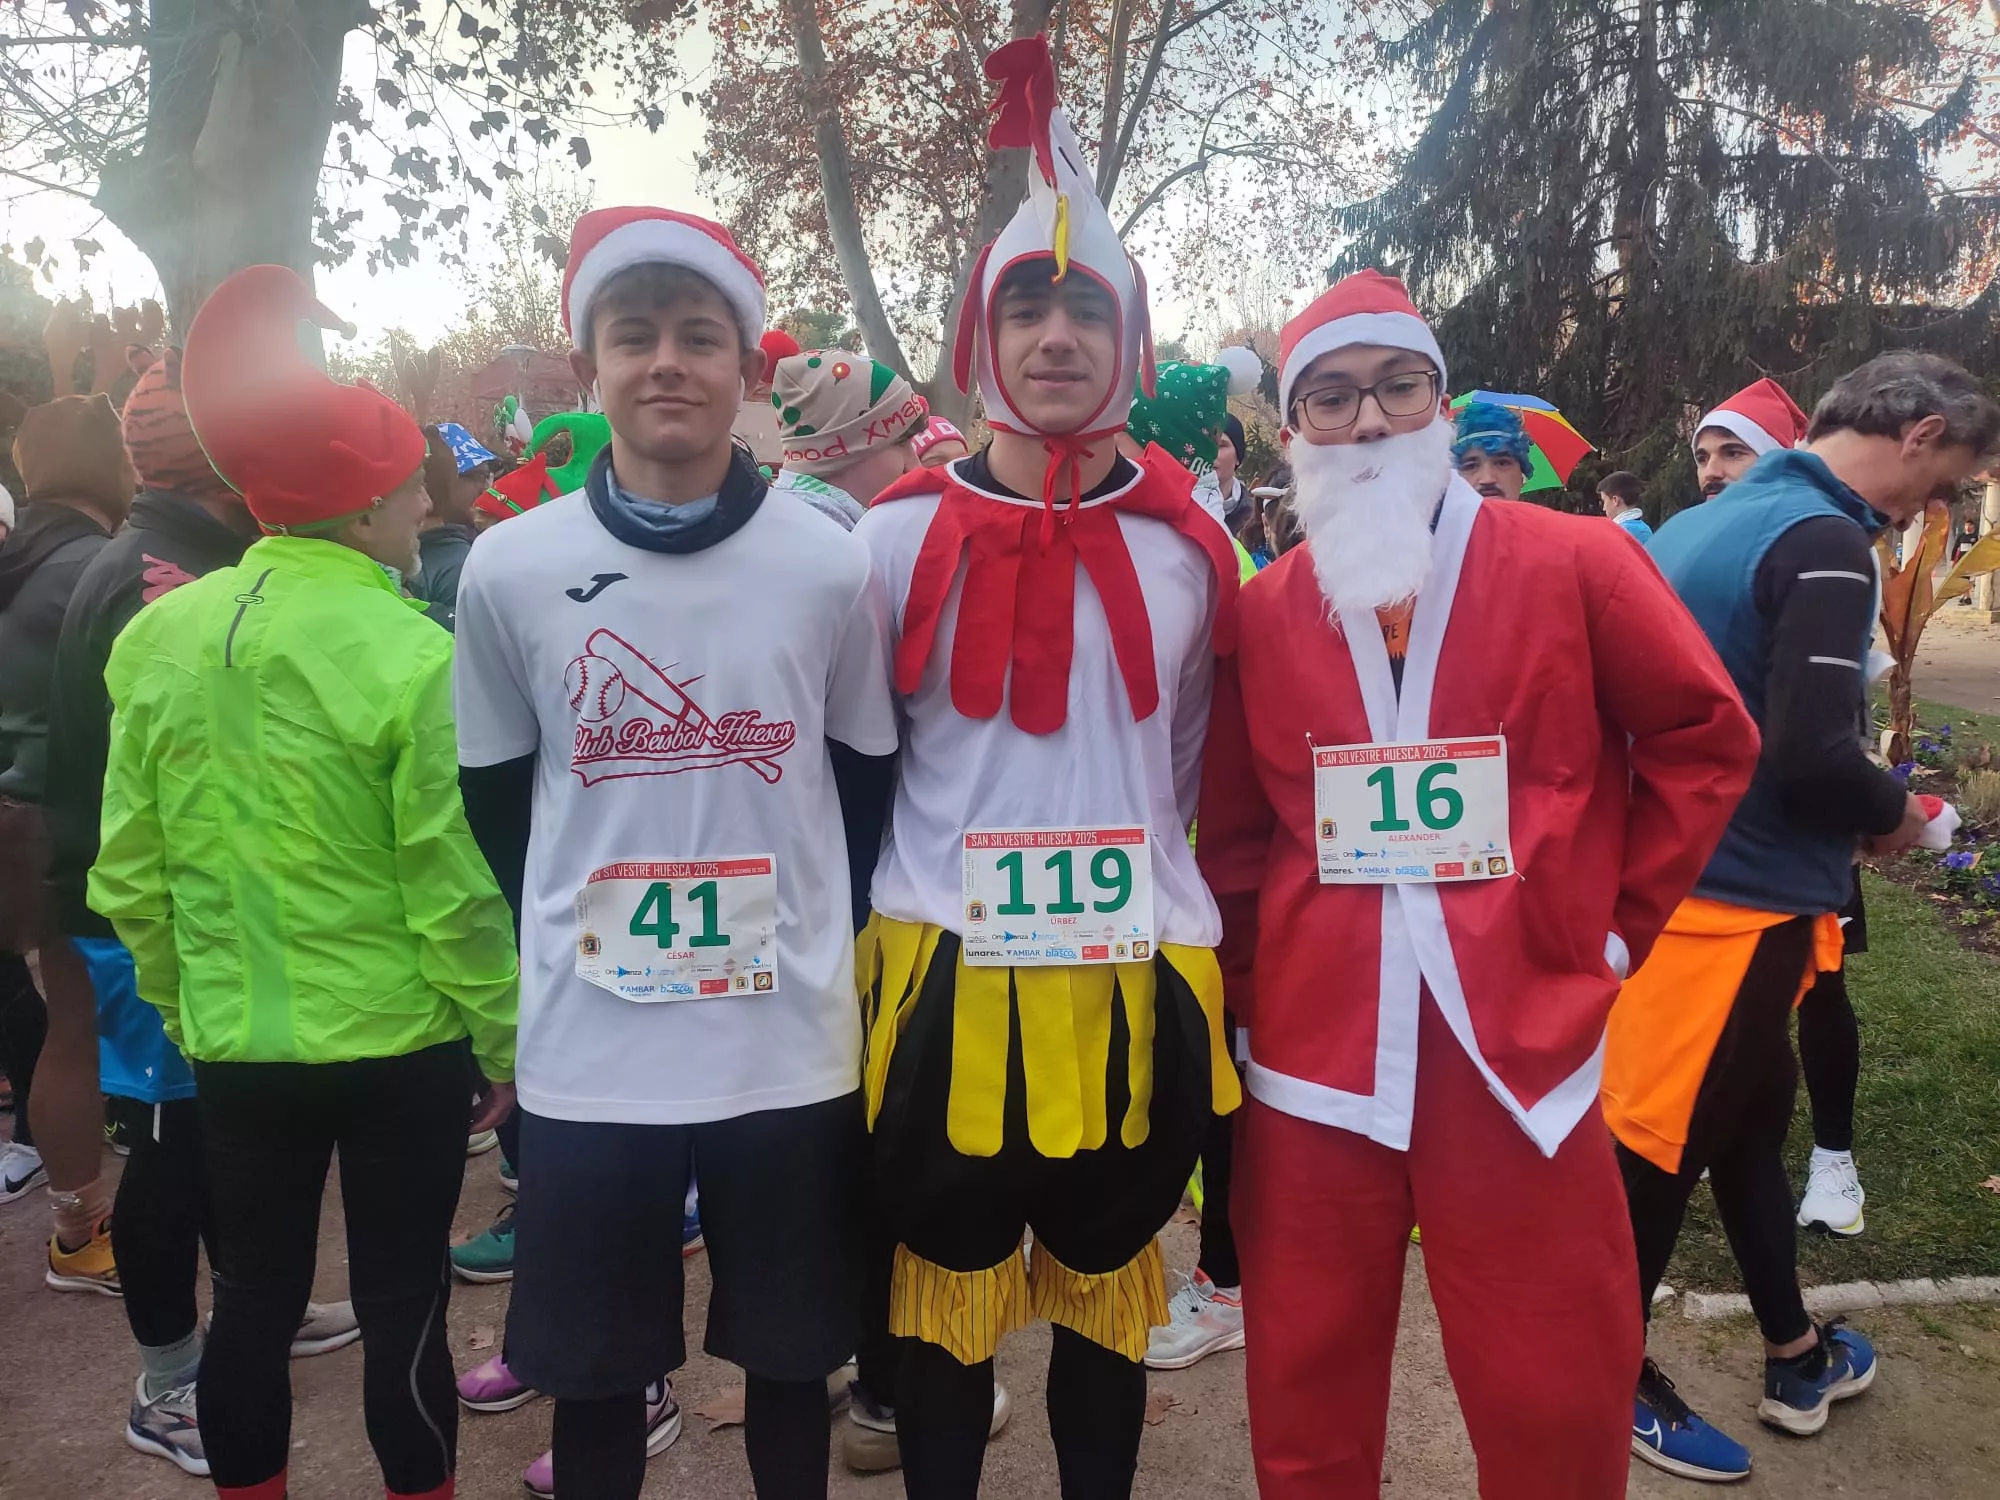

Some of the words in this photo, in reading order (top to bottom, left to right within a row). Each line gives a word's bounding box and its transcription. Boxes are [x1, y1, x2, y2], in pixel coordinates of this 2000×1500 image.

[712, 710, 796, 746] Huesca
[1321, 752, 1337, 765] SAN
[1339, 749, 1380, 764] SILVESTRE
[1384, 747, 1420, 761] HUESCA
[1423, 745, 1448, 759] 2025
[1366, 762, 1464, 832] 16
[970, 833, 989, 847] SAN
[991, 833, 1035, 846] SILVESTRE
[1038, 832, 1073, 846] HUESCA
[1075, 831, 1097, 844] 2025
[1388, 833, 1441, 842] ALEXANDER
[588, 869, 601, 882] AN
[603, 863, 651, 879] SILVESTRE
[653, 862, 692, 877] HUESCA
[694, 863, 719, 876] 2025
[1363, 866, 1390, 874] AMBAR
[996, 847, 1133, 915] 119
[629, 880, 731, 949] 41
[666, 951, 695, 960] CÉSAR
[1013, 949, 1041, 957] AMBAR
[625, 985, 656, 993] AMBAR
